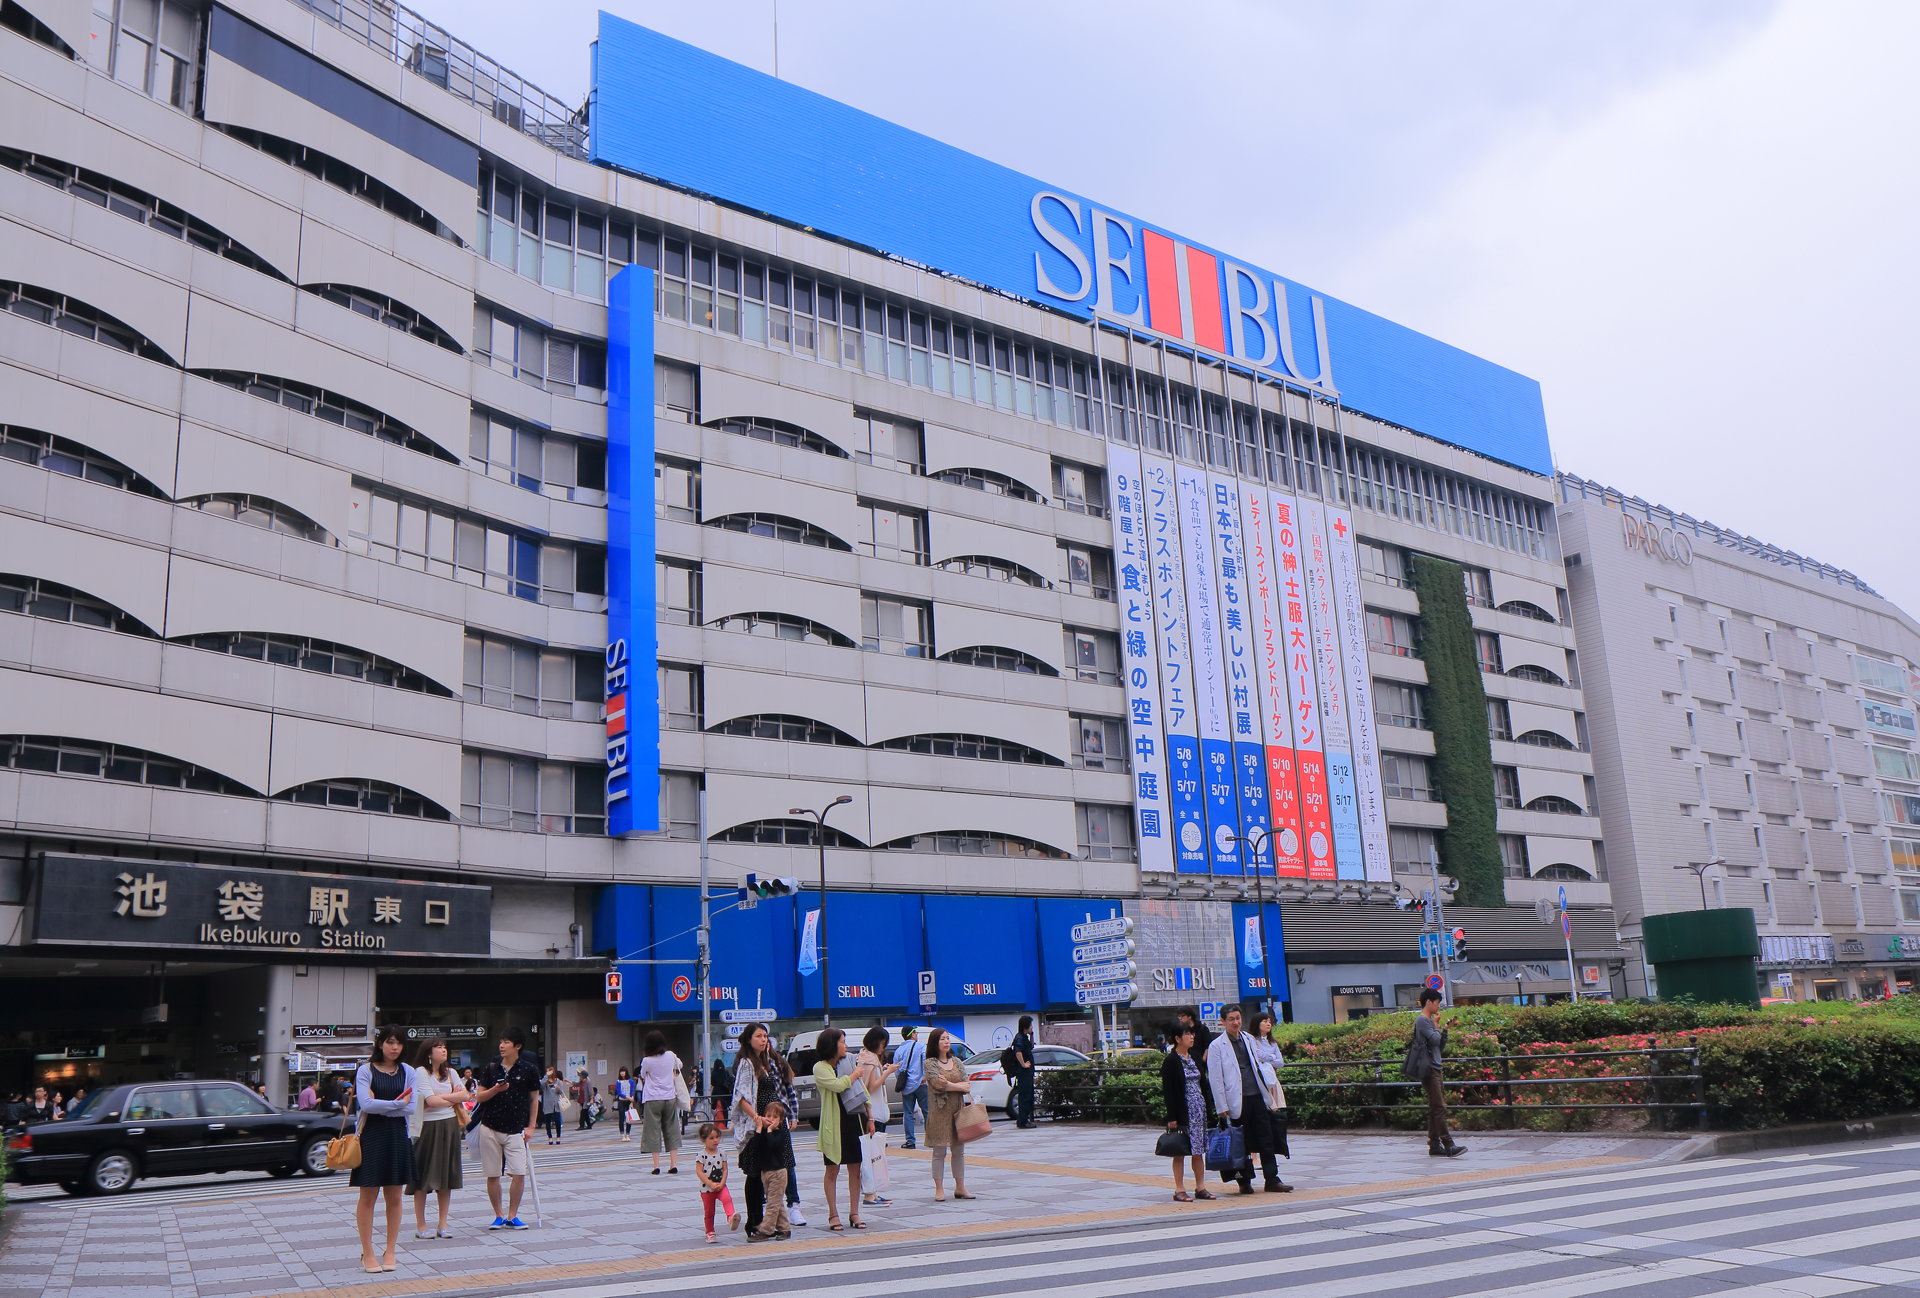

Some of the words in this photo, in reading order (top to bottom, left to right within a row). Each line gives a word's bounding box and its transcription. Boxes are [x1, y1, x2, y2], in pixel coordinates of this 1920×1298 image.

[1030, 190, 1343, 396] SEIBU
[1622, 512, 1693, 567] PARCO
[1151, 488, 1185, 728] プラスポイントフェア
[1214, 483, 1252, 735] 日本で最も美しい村展
[1276, 502, 1315, 745] 夏の紳士服大バーゲン
[606, 638, 627, 804] SEIBU
[1176, 747, 1192, 761] 5/8
[1211, 752, 1226, 765] 5/8
[1243, 754, 1258, 767] 5/8
[1272, 758, 1291, 770] 5/10
[1303, 762, 1321, 774] 5/14
[1333, 765, 1349, 776] 5/12
[1177, 780, 1197, 793] 5/17
[1211, 784, 1230, 797] 5/17
[1244, 786, 1263, 798] 5/13
[1275, 788, 1294, 801] 5/14
[1306, 793, 1323, 804] 5/21
[1335, 795, 1352, 806] 5/17
[113, 872, 450, 926] 池袋駅東口
[200, 923, 301, 946] Ikebukuro
[321, 928, 386, 949] Station
[921, 974, 932, 991] P
[1152, 967, 1217, 991] SEIBU
[838, 985, 876, 998] SEIBU
[963, 983, 997, 996] SEIBU
[1340, 987, 1355, 995] LOUIS
